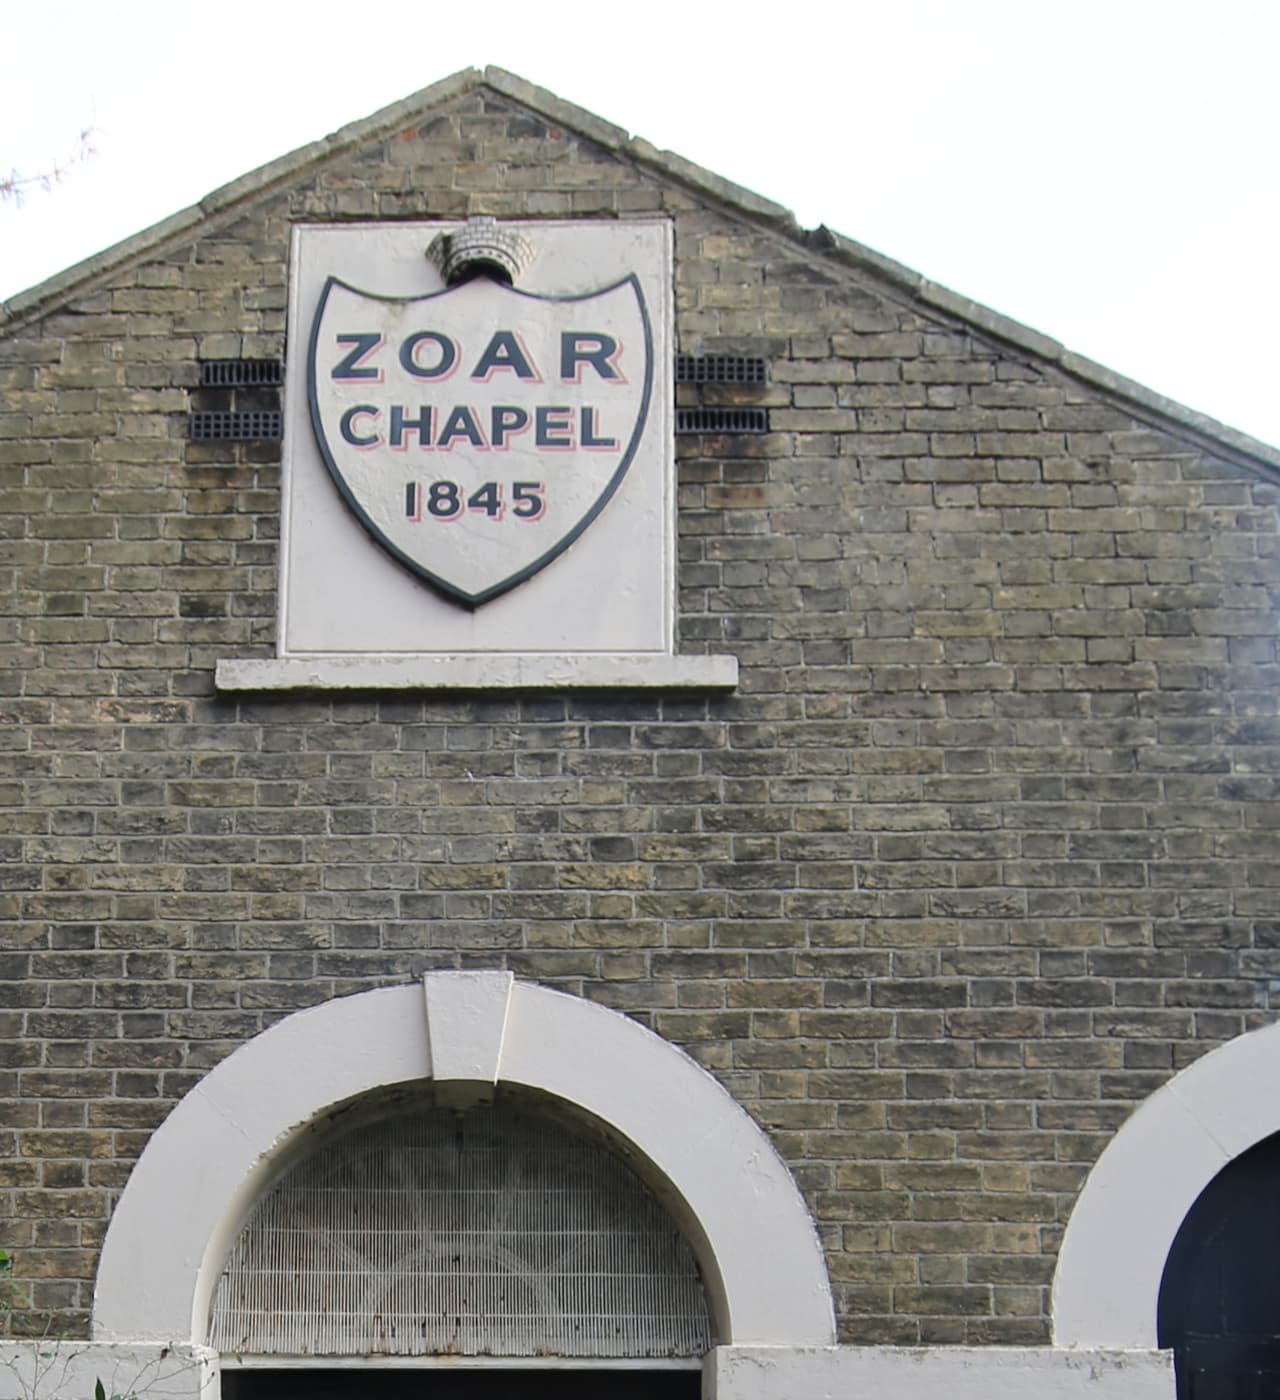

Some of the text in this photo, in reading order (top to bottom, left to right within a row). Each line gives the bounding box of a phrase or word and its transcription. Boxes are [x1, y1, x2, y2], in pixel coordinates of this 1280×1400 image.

[331, 331, 627, 384] ZOAR
[339, 404, 620, 452] CHAPEL
[405, 480, 545, 522] 1845
